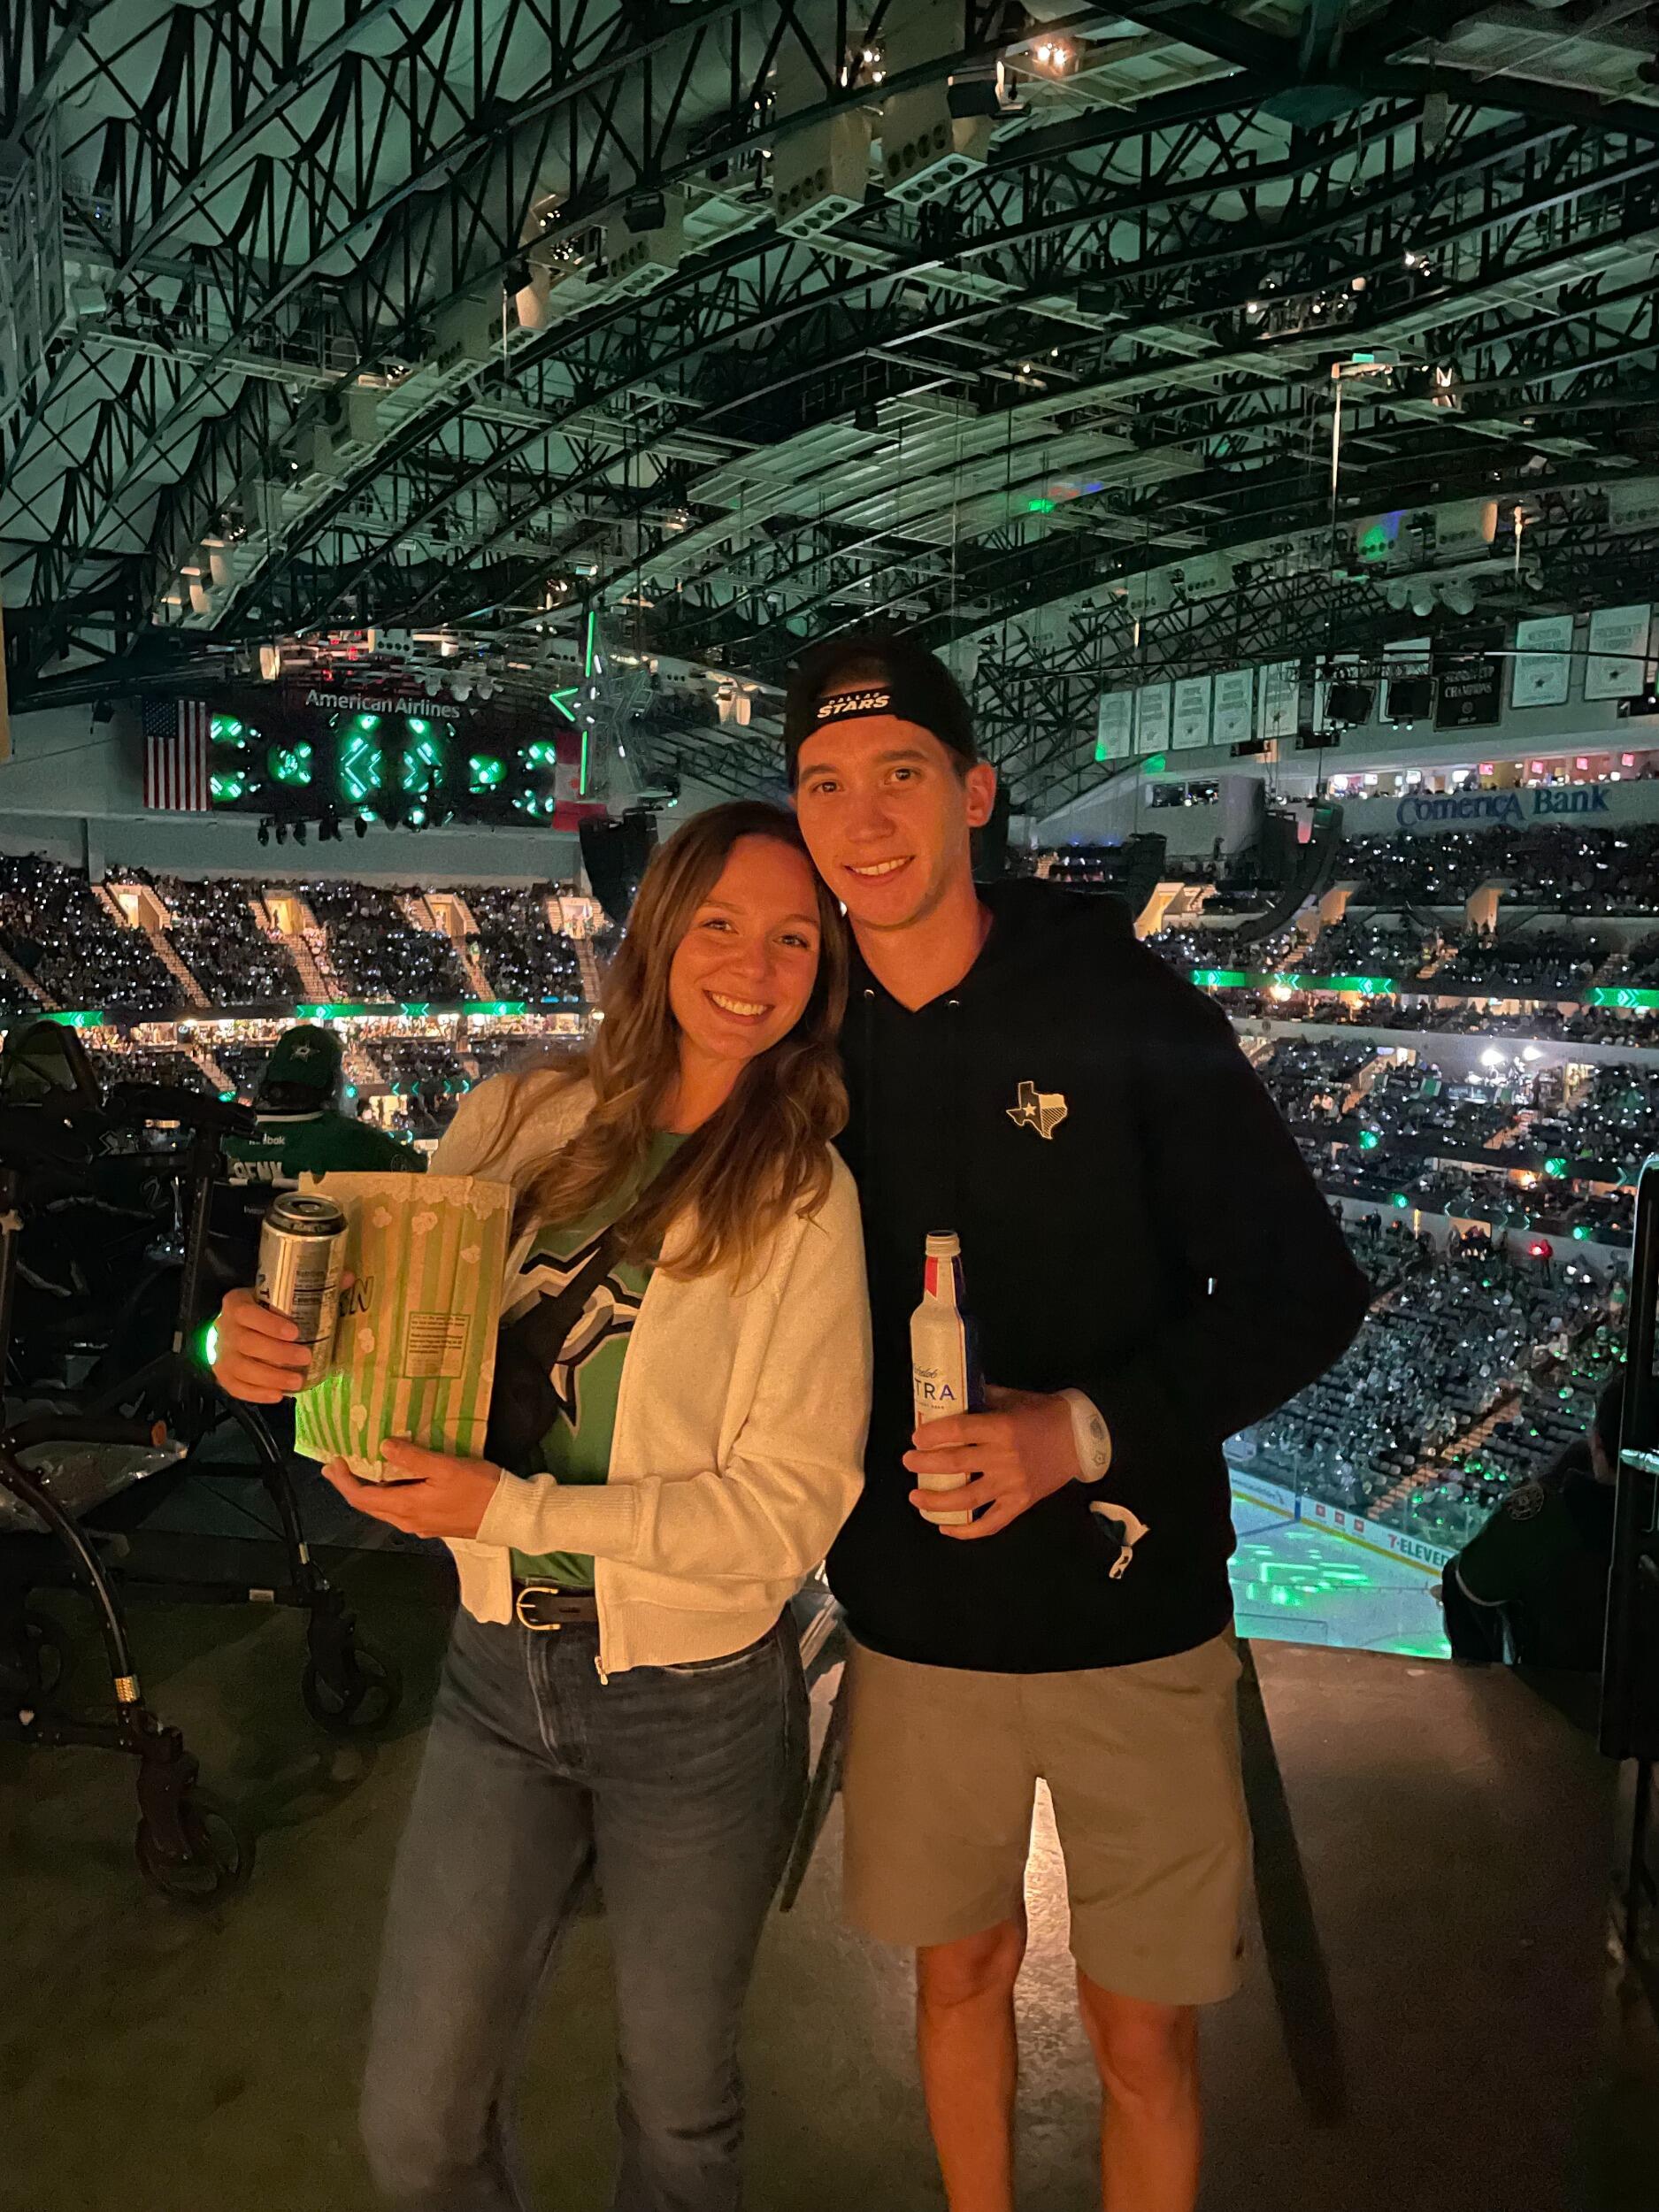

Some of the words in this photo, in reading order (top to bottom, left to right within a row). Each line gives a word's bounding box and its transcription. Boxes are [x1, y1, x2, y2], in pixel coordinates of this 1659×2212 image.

[305, 688, 392, 713] American
[395, 697, 460, 718] Airlines
[817, 695, 891, 718] STARS
[828, 692, 880, 705] DALLAS
[1532, 785, 1610, 815] Bank
[914, 1378, 956, 1401] TRA
